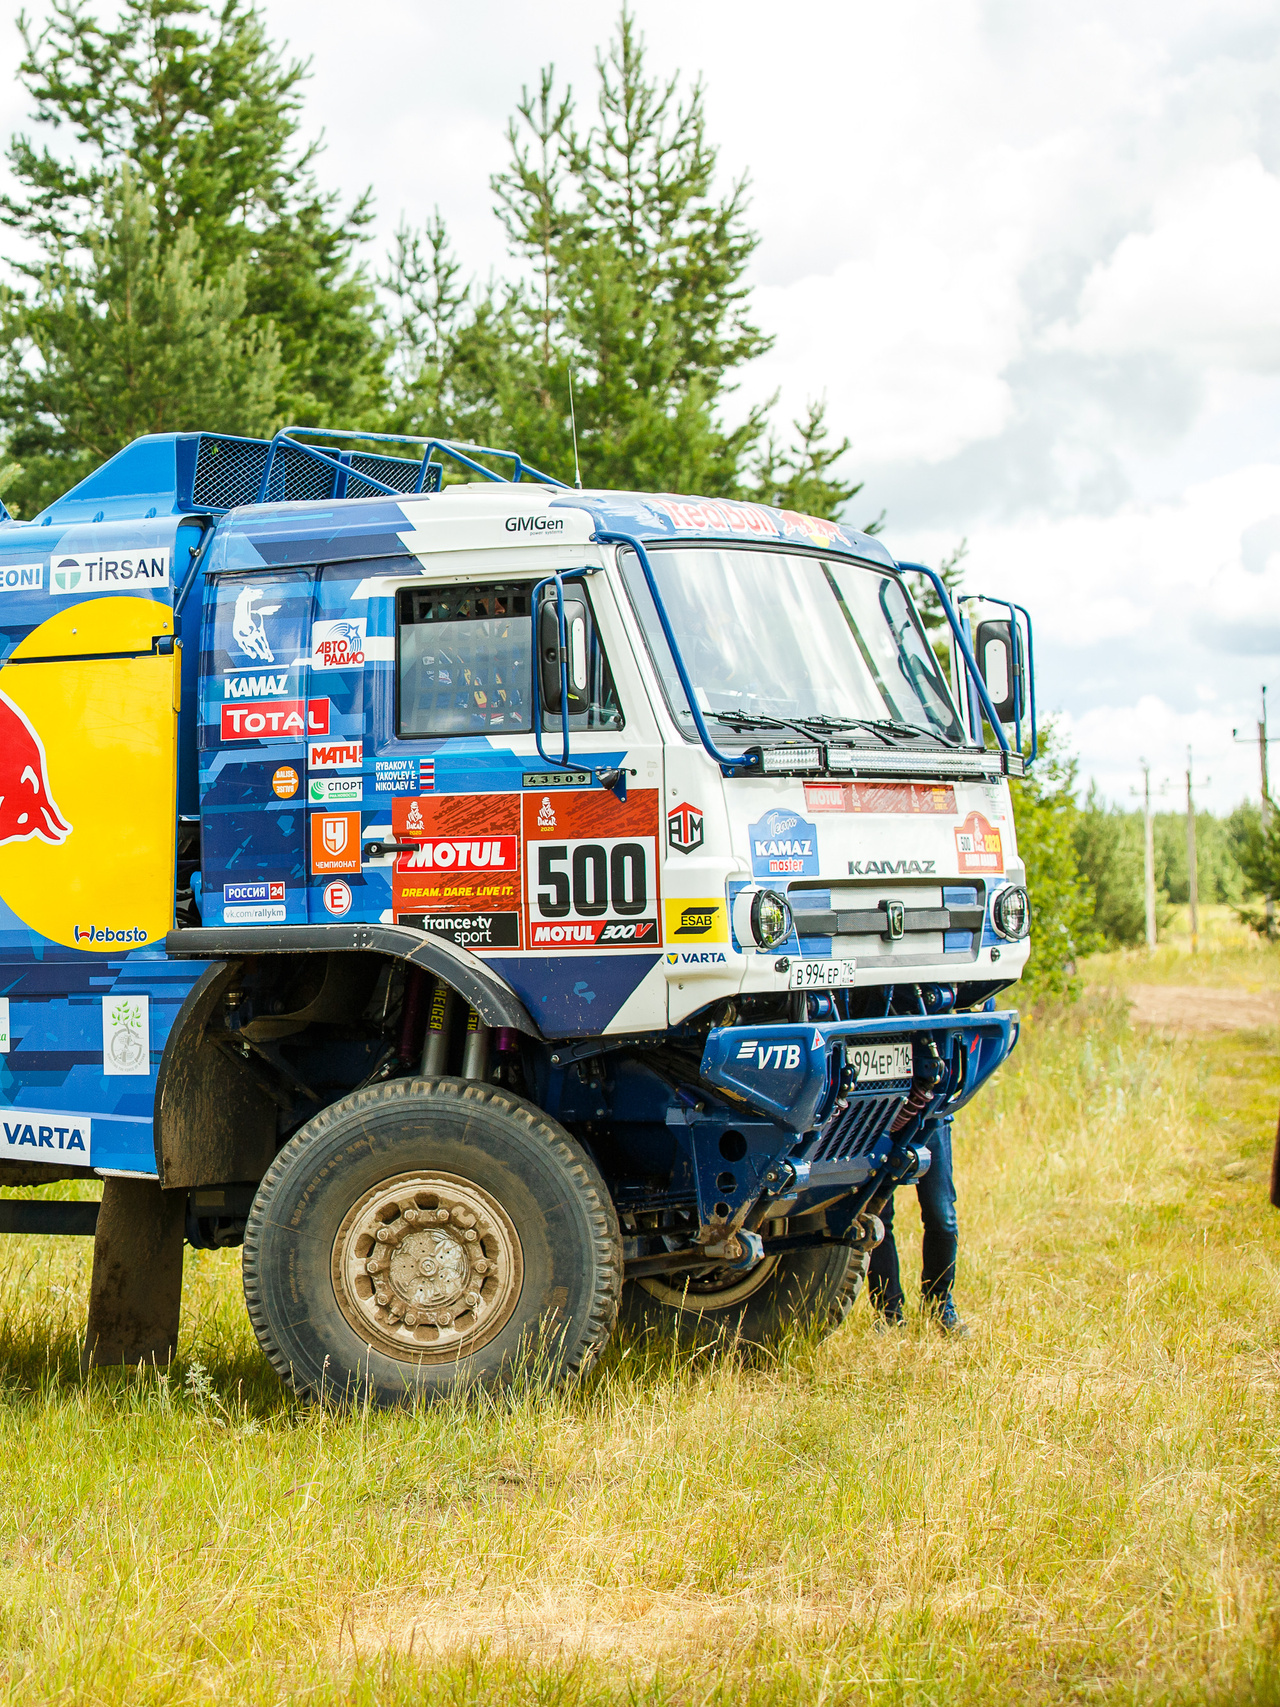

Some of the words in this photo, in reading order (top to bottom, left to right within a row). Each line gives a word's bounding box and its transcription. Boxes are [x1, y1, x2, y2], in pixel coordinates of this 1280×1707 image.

[505, 515, 564, 531] GMGen
[315, 639, 348, 655] АВТО
[323, 651, 365, 666] РАДИО
[223, 674, 289, 699] KAMAZ
[226, 709, 325, 733] TOTAL
[375, 760, 407, 771] RYBAKOV
[408, 760, 415, 770] V.
[375, 770, 410, 781] YAKOVLEV
[411, 770, 418, 780] E.
[327, 781, 364, 791] СПОРТ
[375, 781, 409, 791] NIKOLAEV
[410, 780, 417, 790] E.
[808, 789, 843, 805] MOTUL
[766, 811, 797, 837] Team
[754, 839, 813, 857] KAMAZ
[984, 834, 1000, 852] 2020
[407, 841, 506, 868] MOTUL
[315, 860, 357, 869] ЧЕМПИОНАТ
[769, 857, 804, 873] master
[848, 860, 936, 875] KAMAZ
[537, 842, 647, 918] 500
[228, 886, 266, 899] РОССИЯ
[270, 885, 283, 898] 24
[330, 888, 344, 908] E
[401, 887, 442, 897] DREAM.
[443, 887, 475, 897] DARE.
[476, 886, 500, 896] LIVE
[501, 886, 514, 896] IT.
[225, 908, 284, 918] vk.com/rallykm
[681, 915, 713, 926] ESAB
[74, 924, 148, 944] Webasto
[454, 930, 492, 947] sport
[534, 926, 595, 942] MOTUL
[601, 923, 654, 940] 300V
[681, 952, 726, 963] VARTA
[757, 1044, 801, 1070] VTB
[894, 1046, 910, 1067] 716
[2, 1122, 86, 1151] VARTA
